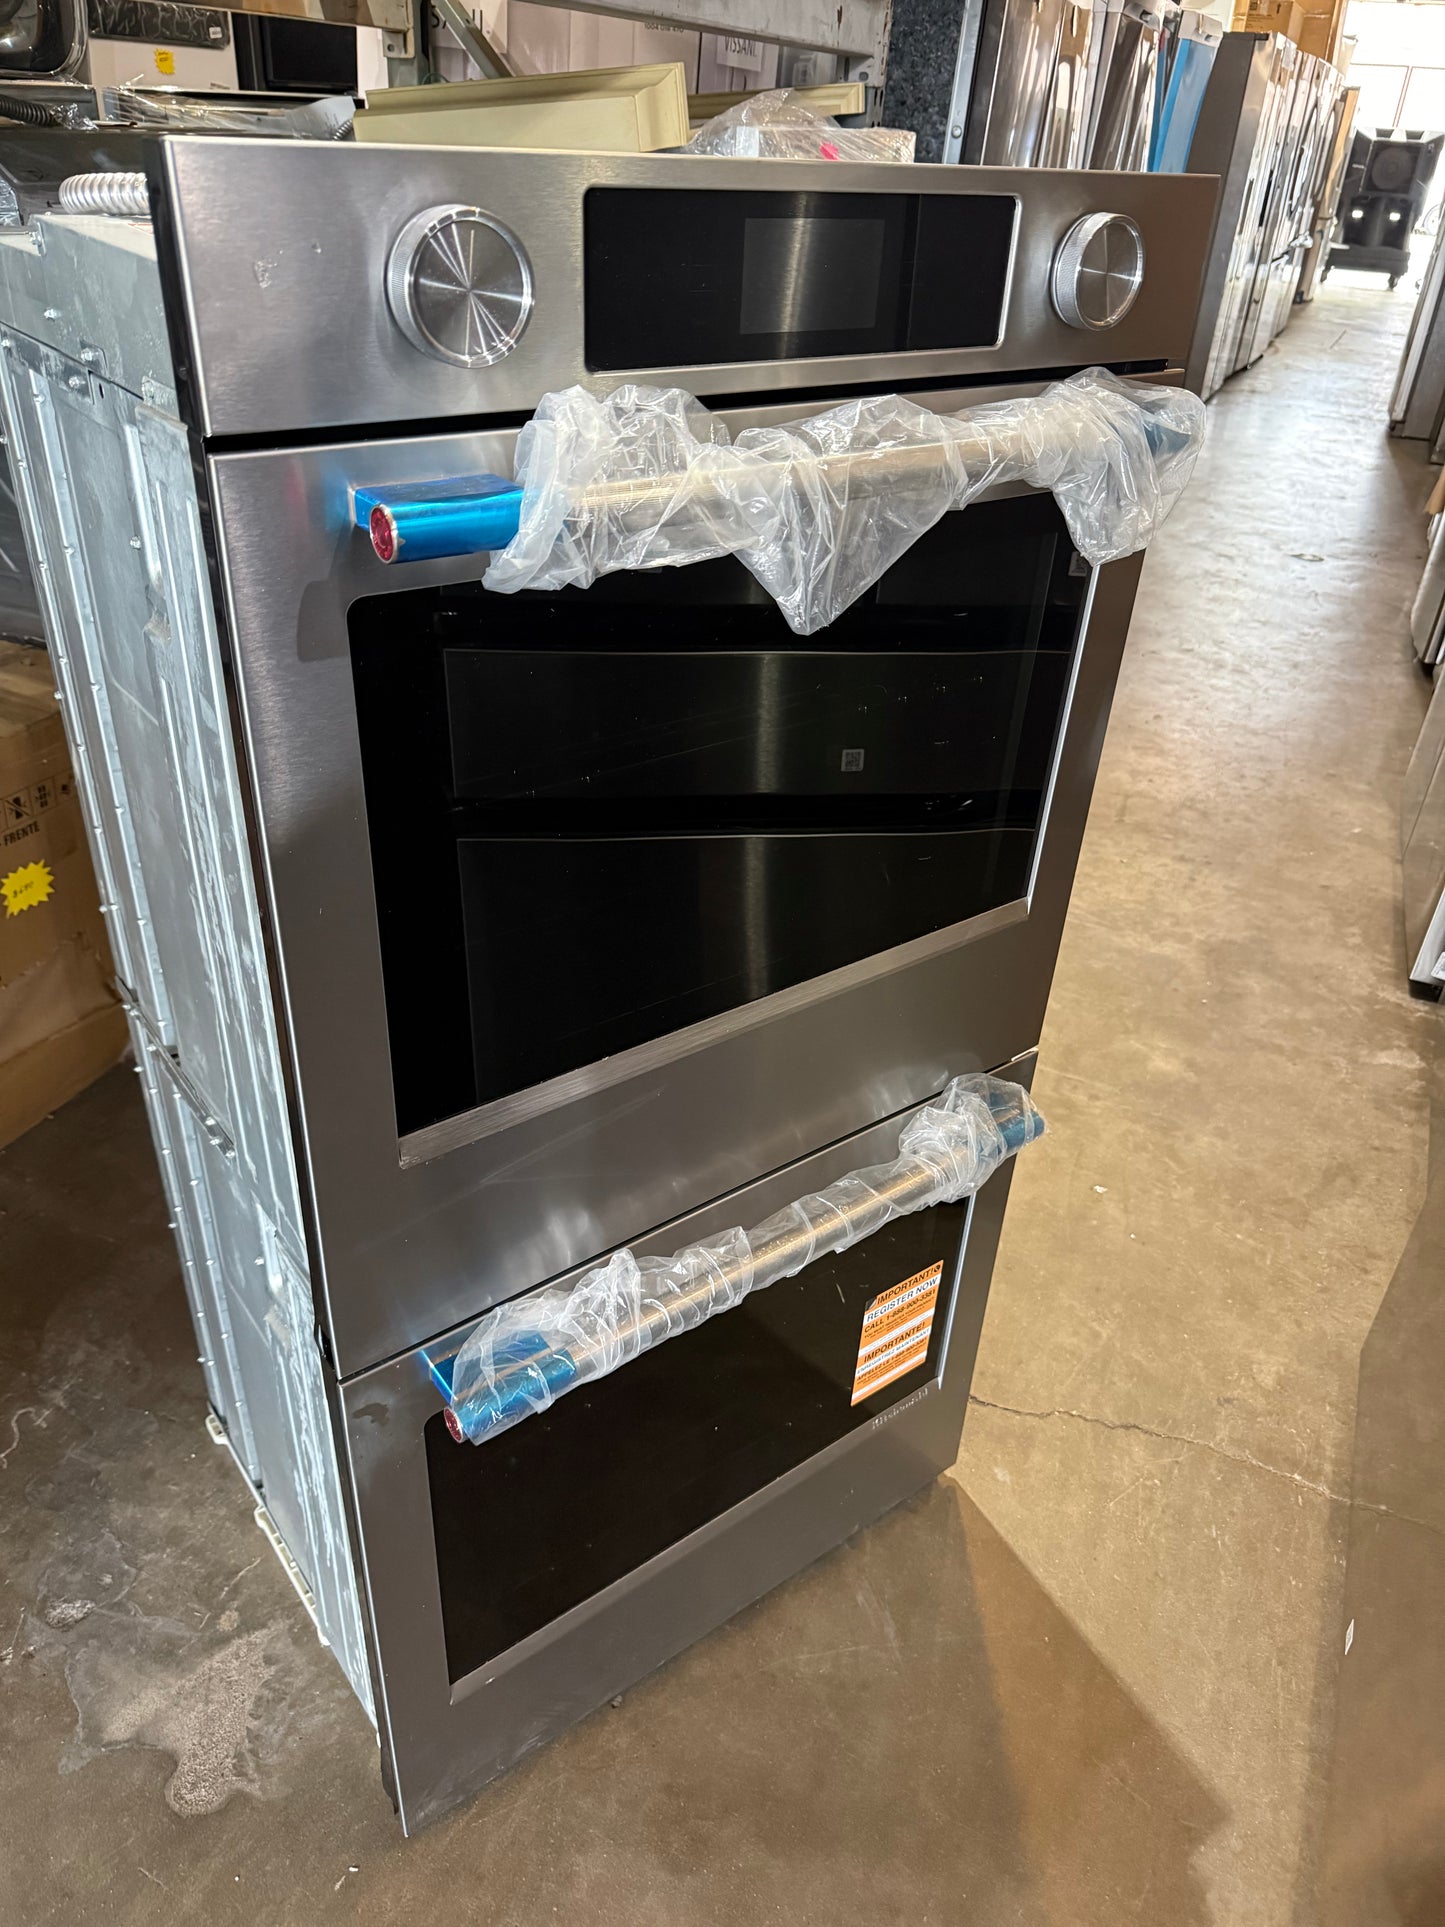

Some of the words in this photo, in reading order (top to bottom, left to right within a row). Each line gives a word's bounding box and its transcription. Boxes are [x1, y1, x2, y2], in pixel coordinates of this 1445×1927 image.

[3, 822, 40, 846] FRENTE
[866, 1290, 913, 1321] REGISTER
[915, 1277, 937, 1294] NOW
[877, 1267, 933, 1304] IMPORTANT!
[863, 1322, 925, 1362] IMPORTANTE!
[864, 1317, 884, 1333] CALL
